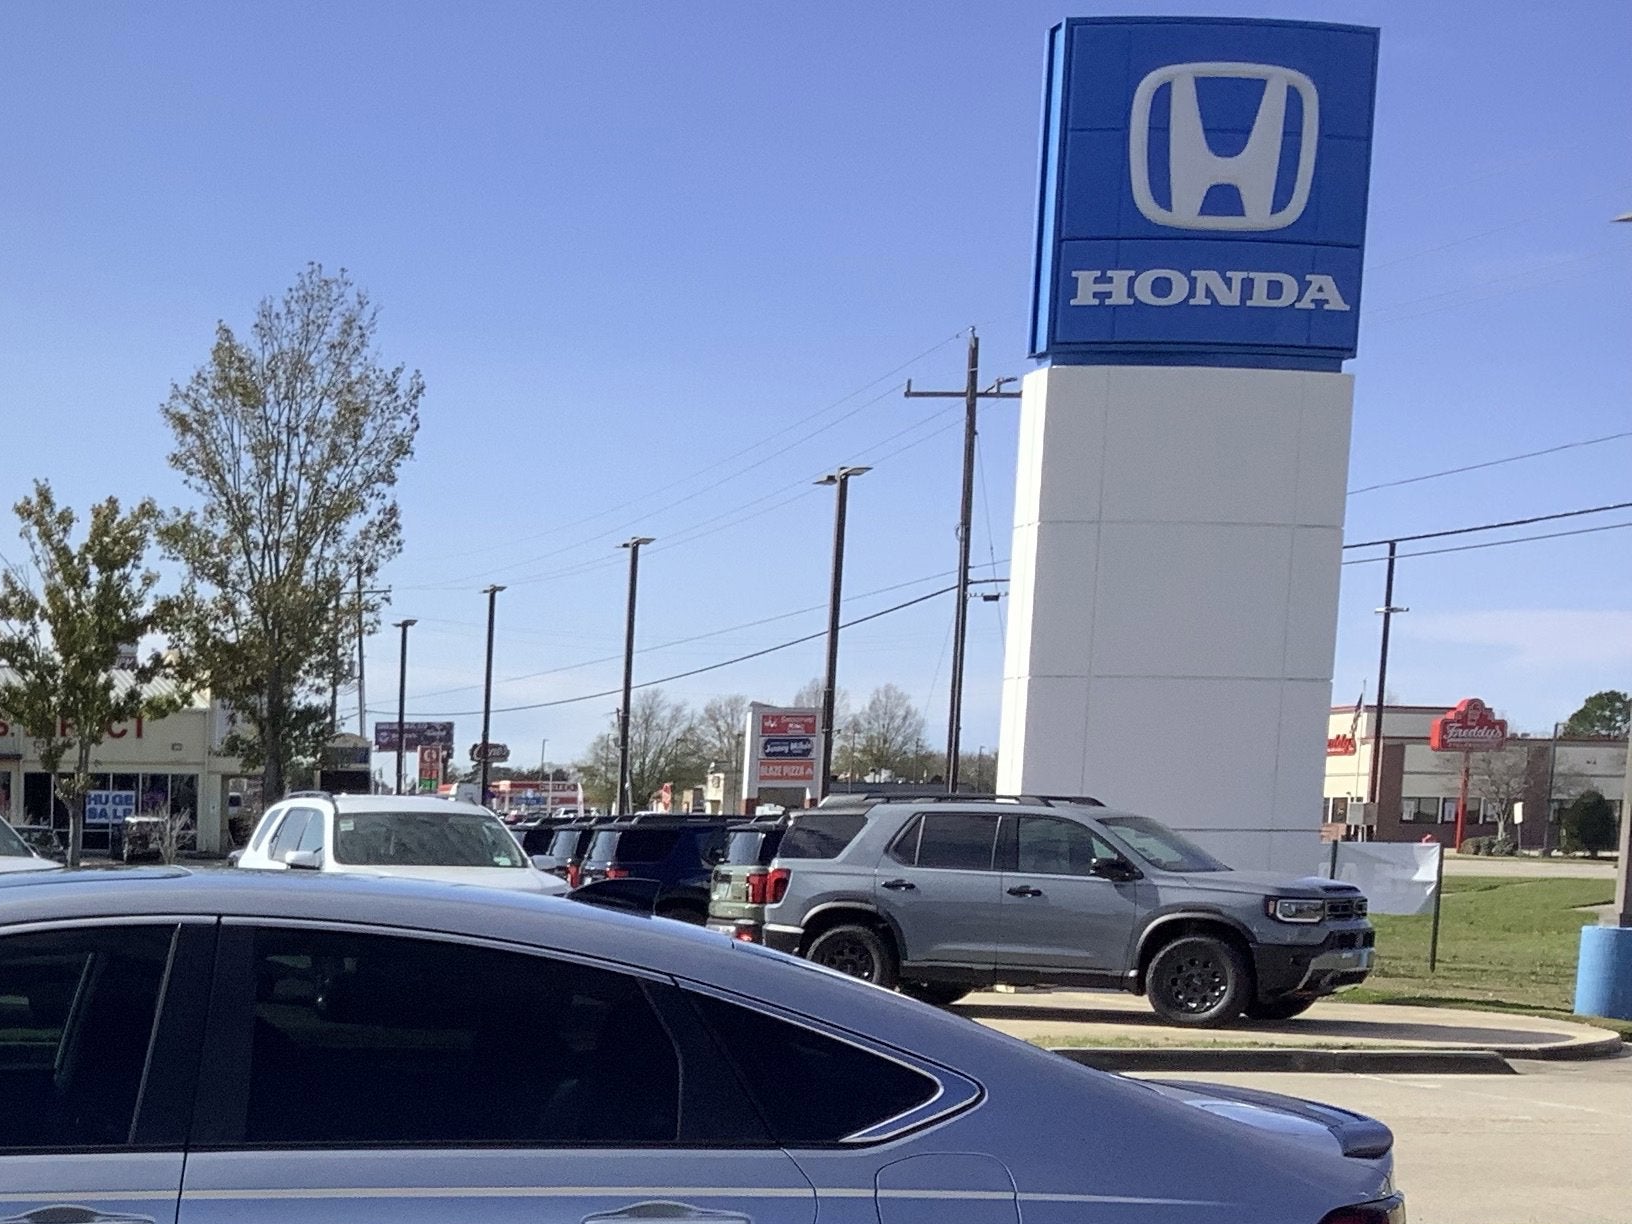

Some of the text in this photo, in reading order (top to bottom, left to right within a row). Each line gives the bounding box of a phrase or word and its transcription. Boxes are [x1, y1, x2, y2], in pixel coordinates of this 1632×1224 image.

[1070, 269, 1350, 311] HONDA
[1443, 723, 1503, 740] Freddy's
[88, 794, 133, 805] HUGE
[88, 808, 132, 819] SALE
